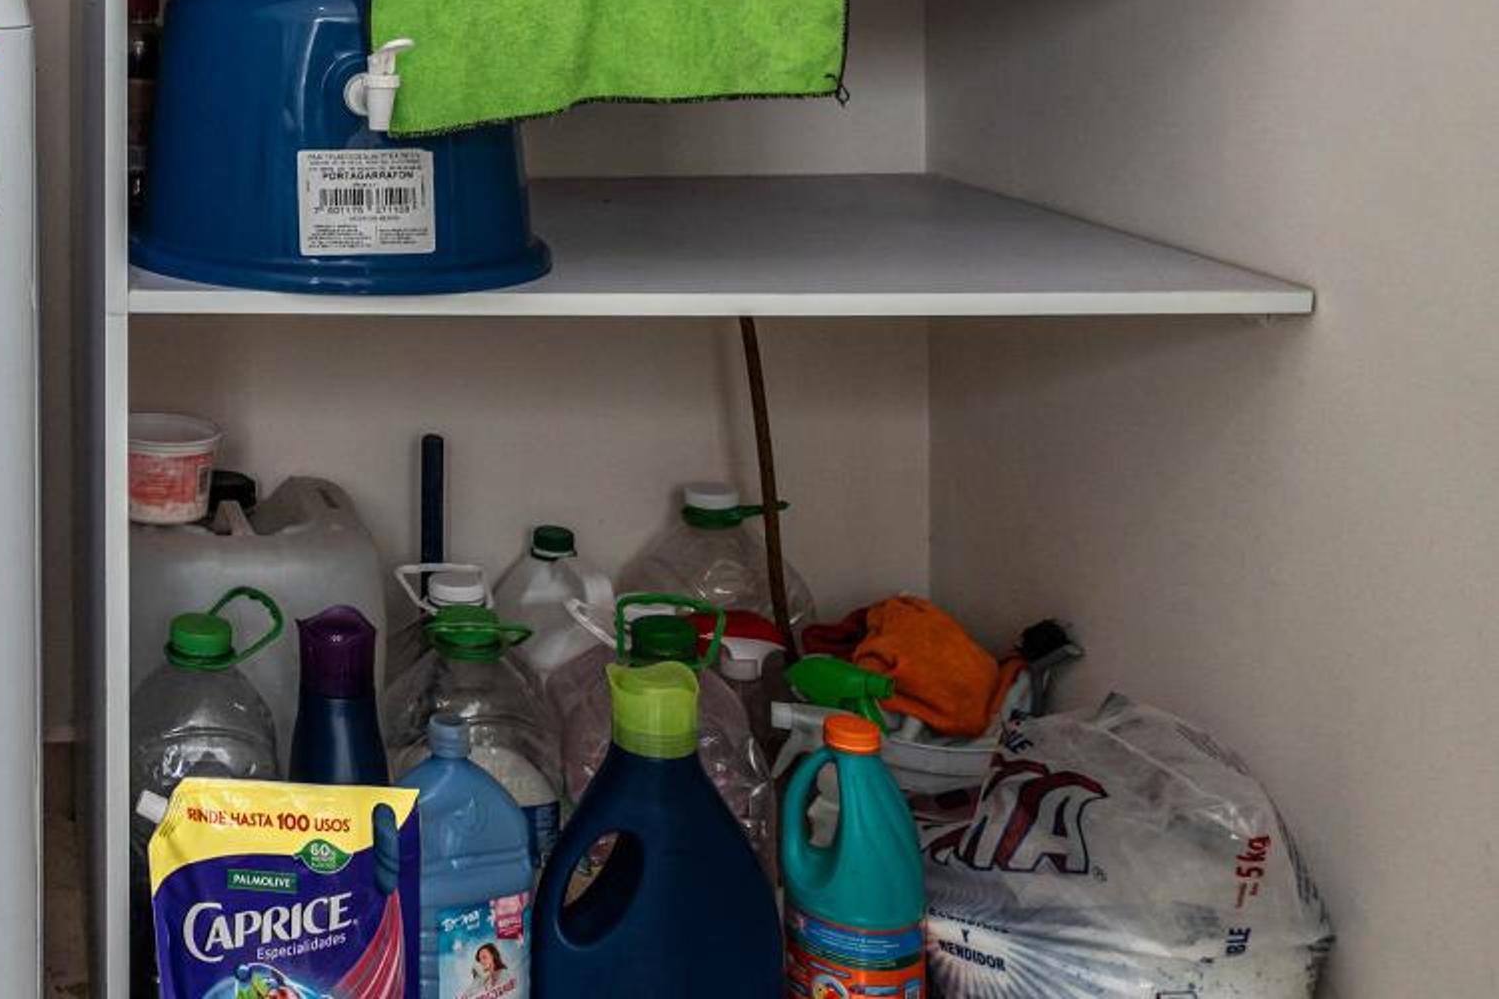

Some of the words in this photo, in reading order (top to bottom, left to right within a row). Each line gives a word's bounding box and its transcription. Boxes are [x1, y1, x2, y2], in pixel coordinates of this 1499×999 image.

[187, 807, 226, 823] RINDE
[230, 811, 273, 827] HASTA
[277, 813, 310, 832] 100
[315, 818, 351, 832] USOS
[232, 873, 292, 888] PALMOLIVE
[183, 892, 353, 962] CAPRICE
[256, 932, 347, 960] Especialidades
